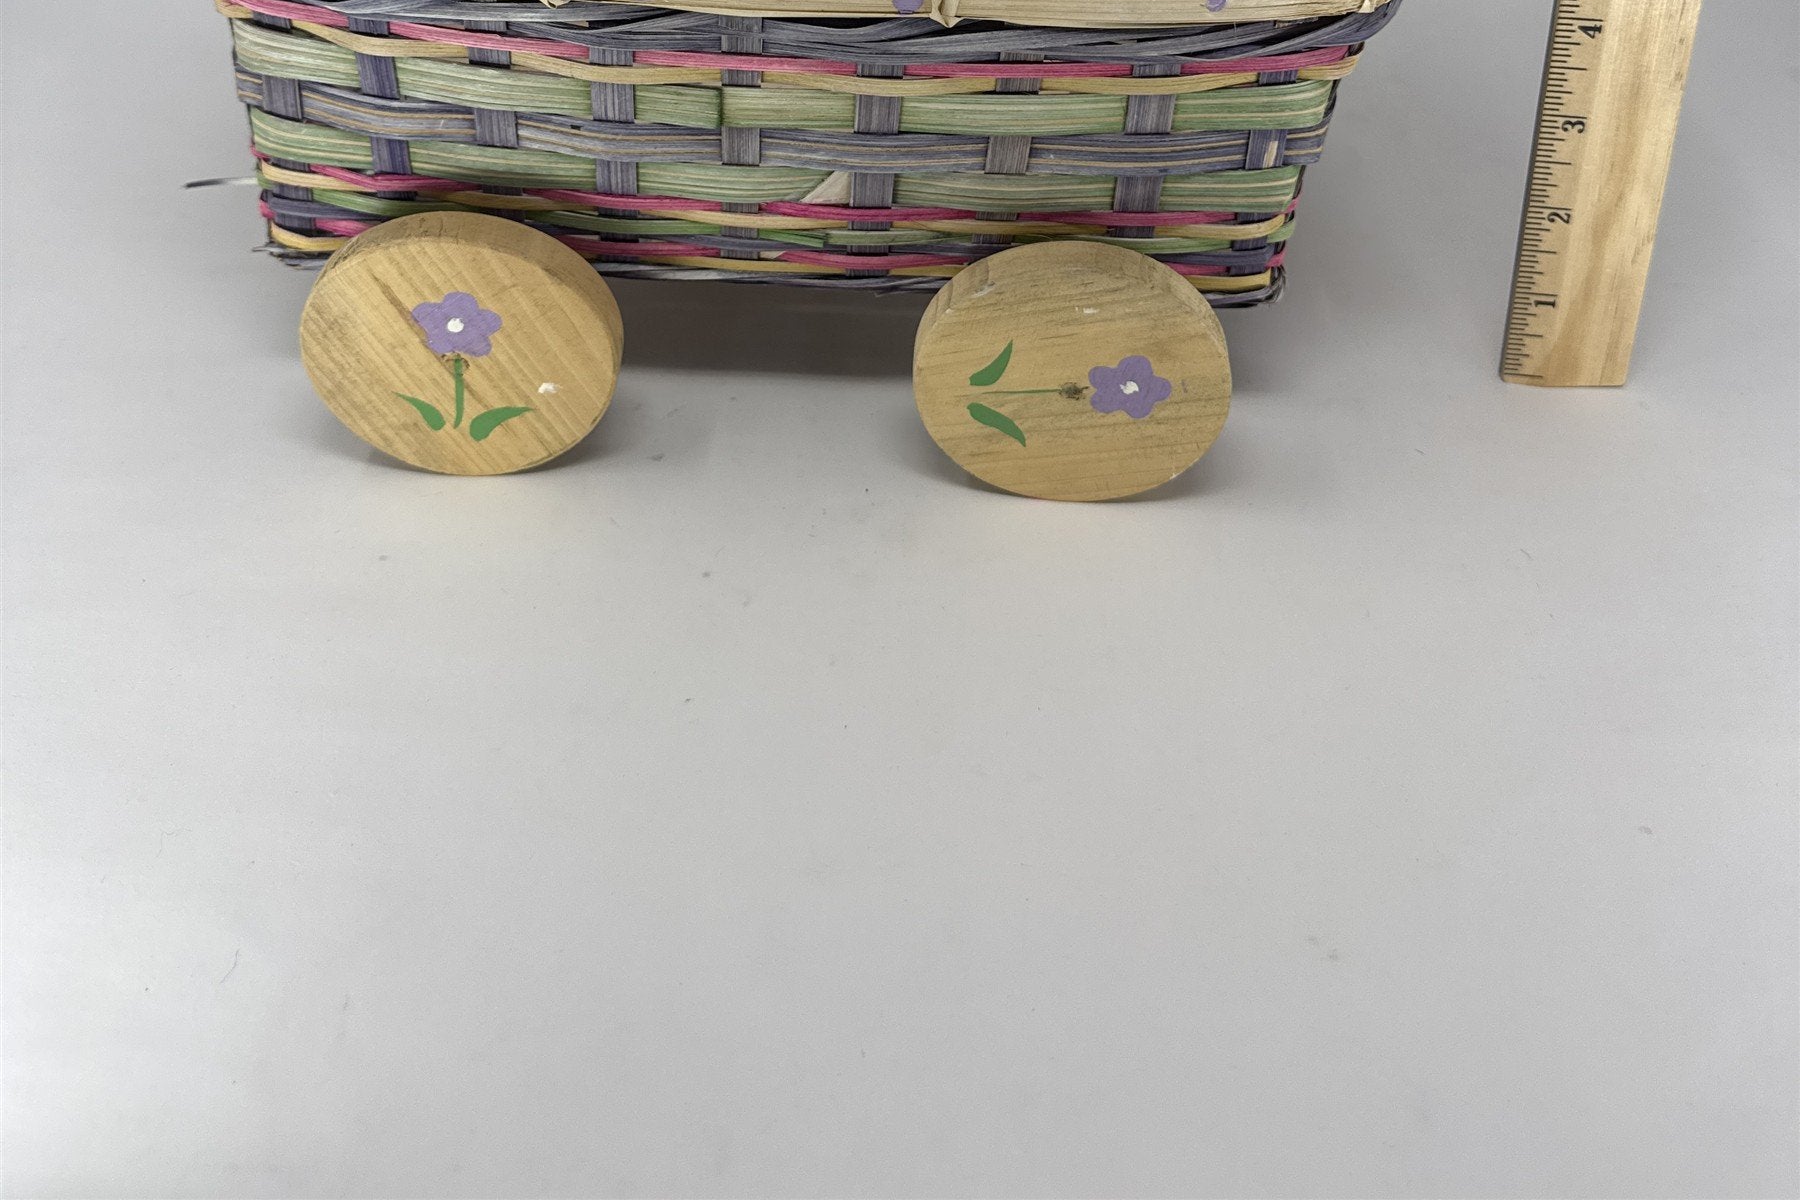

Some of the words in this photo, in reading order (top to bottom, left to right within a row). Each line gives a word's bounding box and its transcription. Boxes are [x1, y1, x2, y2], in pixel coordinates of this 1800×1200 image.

[1578, 24, 1603, 39] 4
[1561, 120, 1586, 134] 3
[1547, 211, 1571, 225] 2
[1534, 299, 1556, 308] 1
